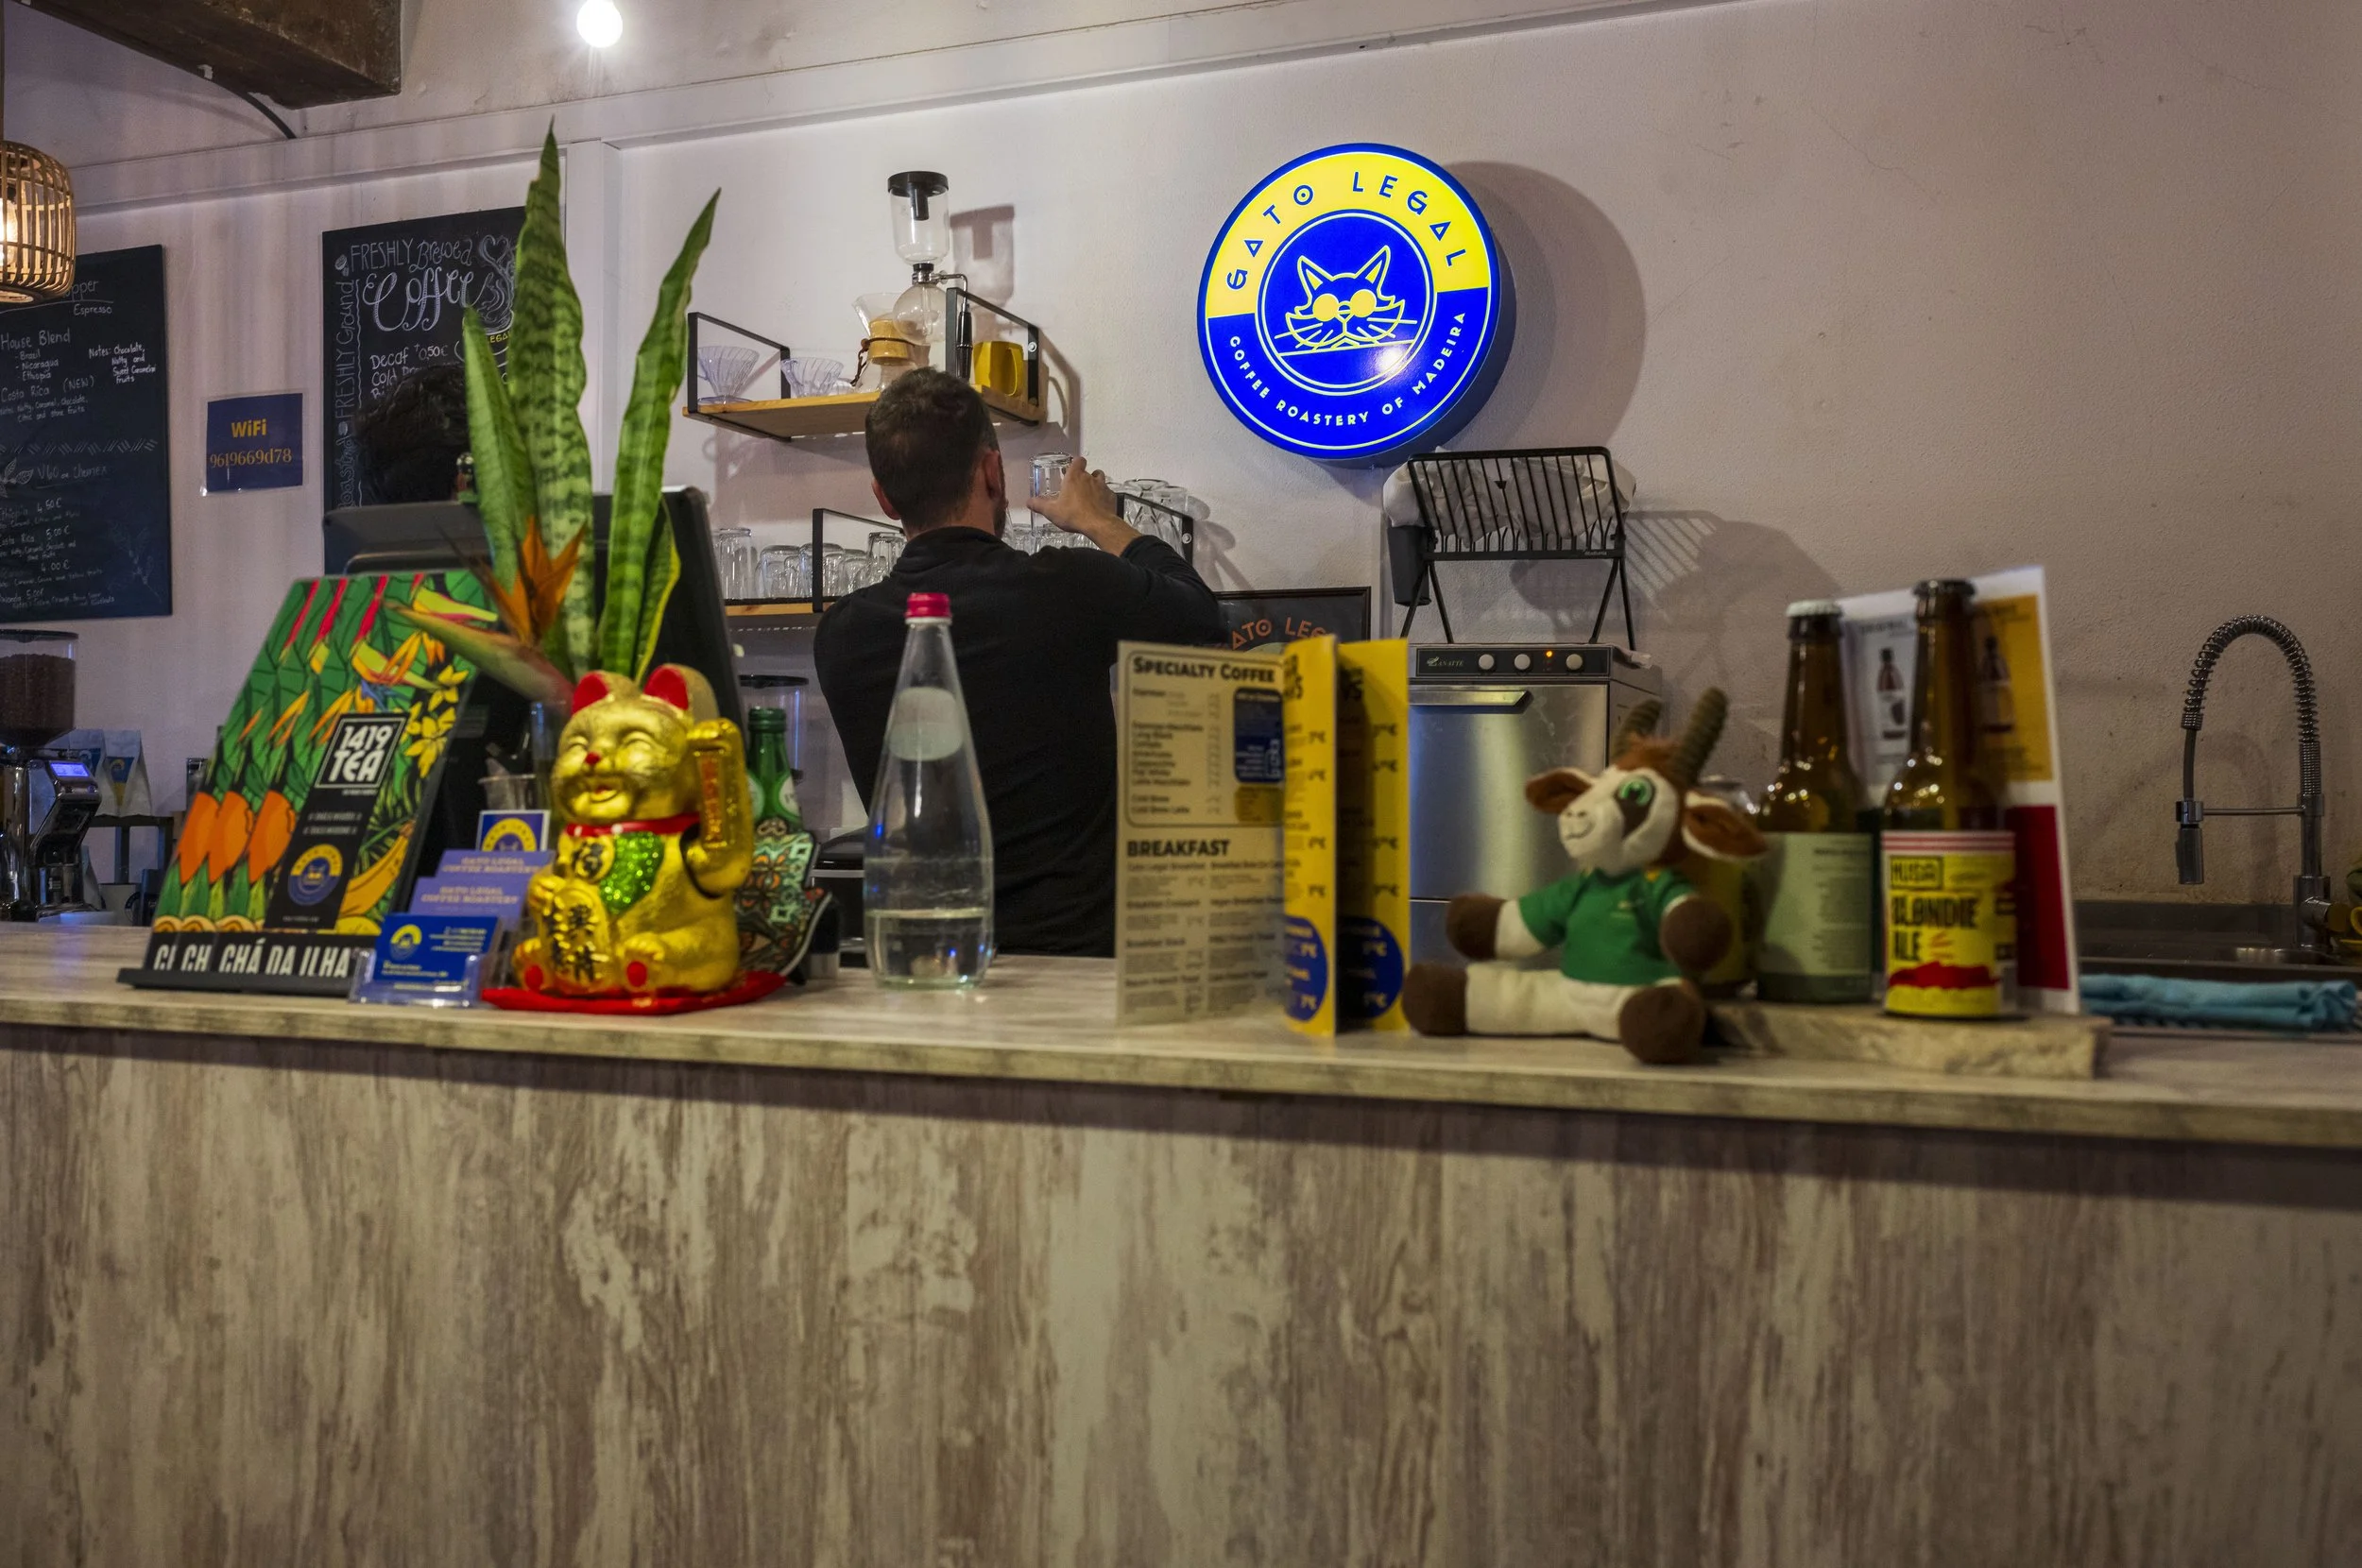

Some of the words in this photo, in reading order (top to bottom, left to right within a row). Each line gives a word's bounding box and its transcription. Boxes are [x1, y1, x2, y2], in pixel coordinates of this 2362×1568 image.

[1225, 183, 1315, 291] GATO
[1352, 171, 1467, 267] LEGAL
[351, 238, 414, 272] FRESHLY
[408, 238, 472, 274] Brewed
[74, 303, 112, 316] Espresso
[335, 280, 356, 345] Ground
[363, 265, 491, 332] Coffee
[0, 332, 33, 350] House
[39, 327, 71, 346] Blend
[489, 330, 512, 344] EGA
[22, 358, 60, 372] Nicaragua
[369, 346, 409, 370] Decaf
[1229, 335, 1271, 400] COFFEE
[1275, 398, 1370, 427] ROASTERY
[1381, 397, 1405, 416] OF
[1412, 312, 1466, 396] MADEIRA
[1, 387, 25, 402] Costa
[30, 385, 50, 397] Rica
[335, 347, 356, 419] FRESHLY
[231, 418, 267, 438] WiFi
[1231, 619, 1273, 651] ATO
[340, 724, 394, 751] 1419
[327, 749, 385, 783] TEA
[1126, 839, 1231, 858] BREAKFAST
[218, 937, 266, 974] CHÁ
[264, 945, 297, 976] DA
[299, 946, 351, 979] ILHA
